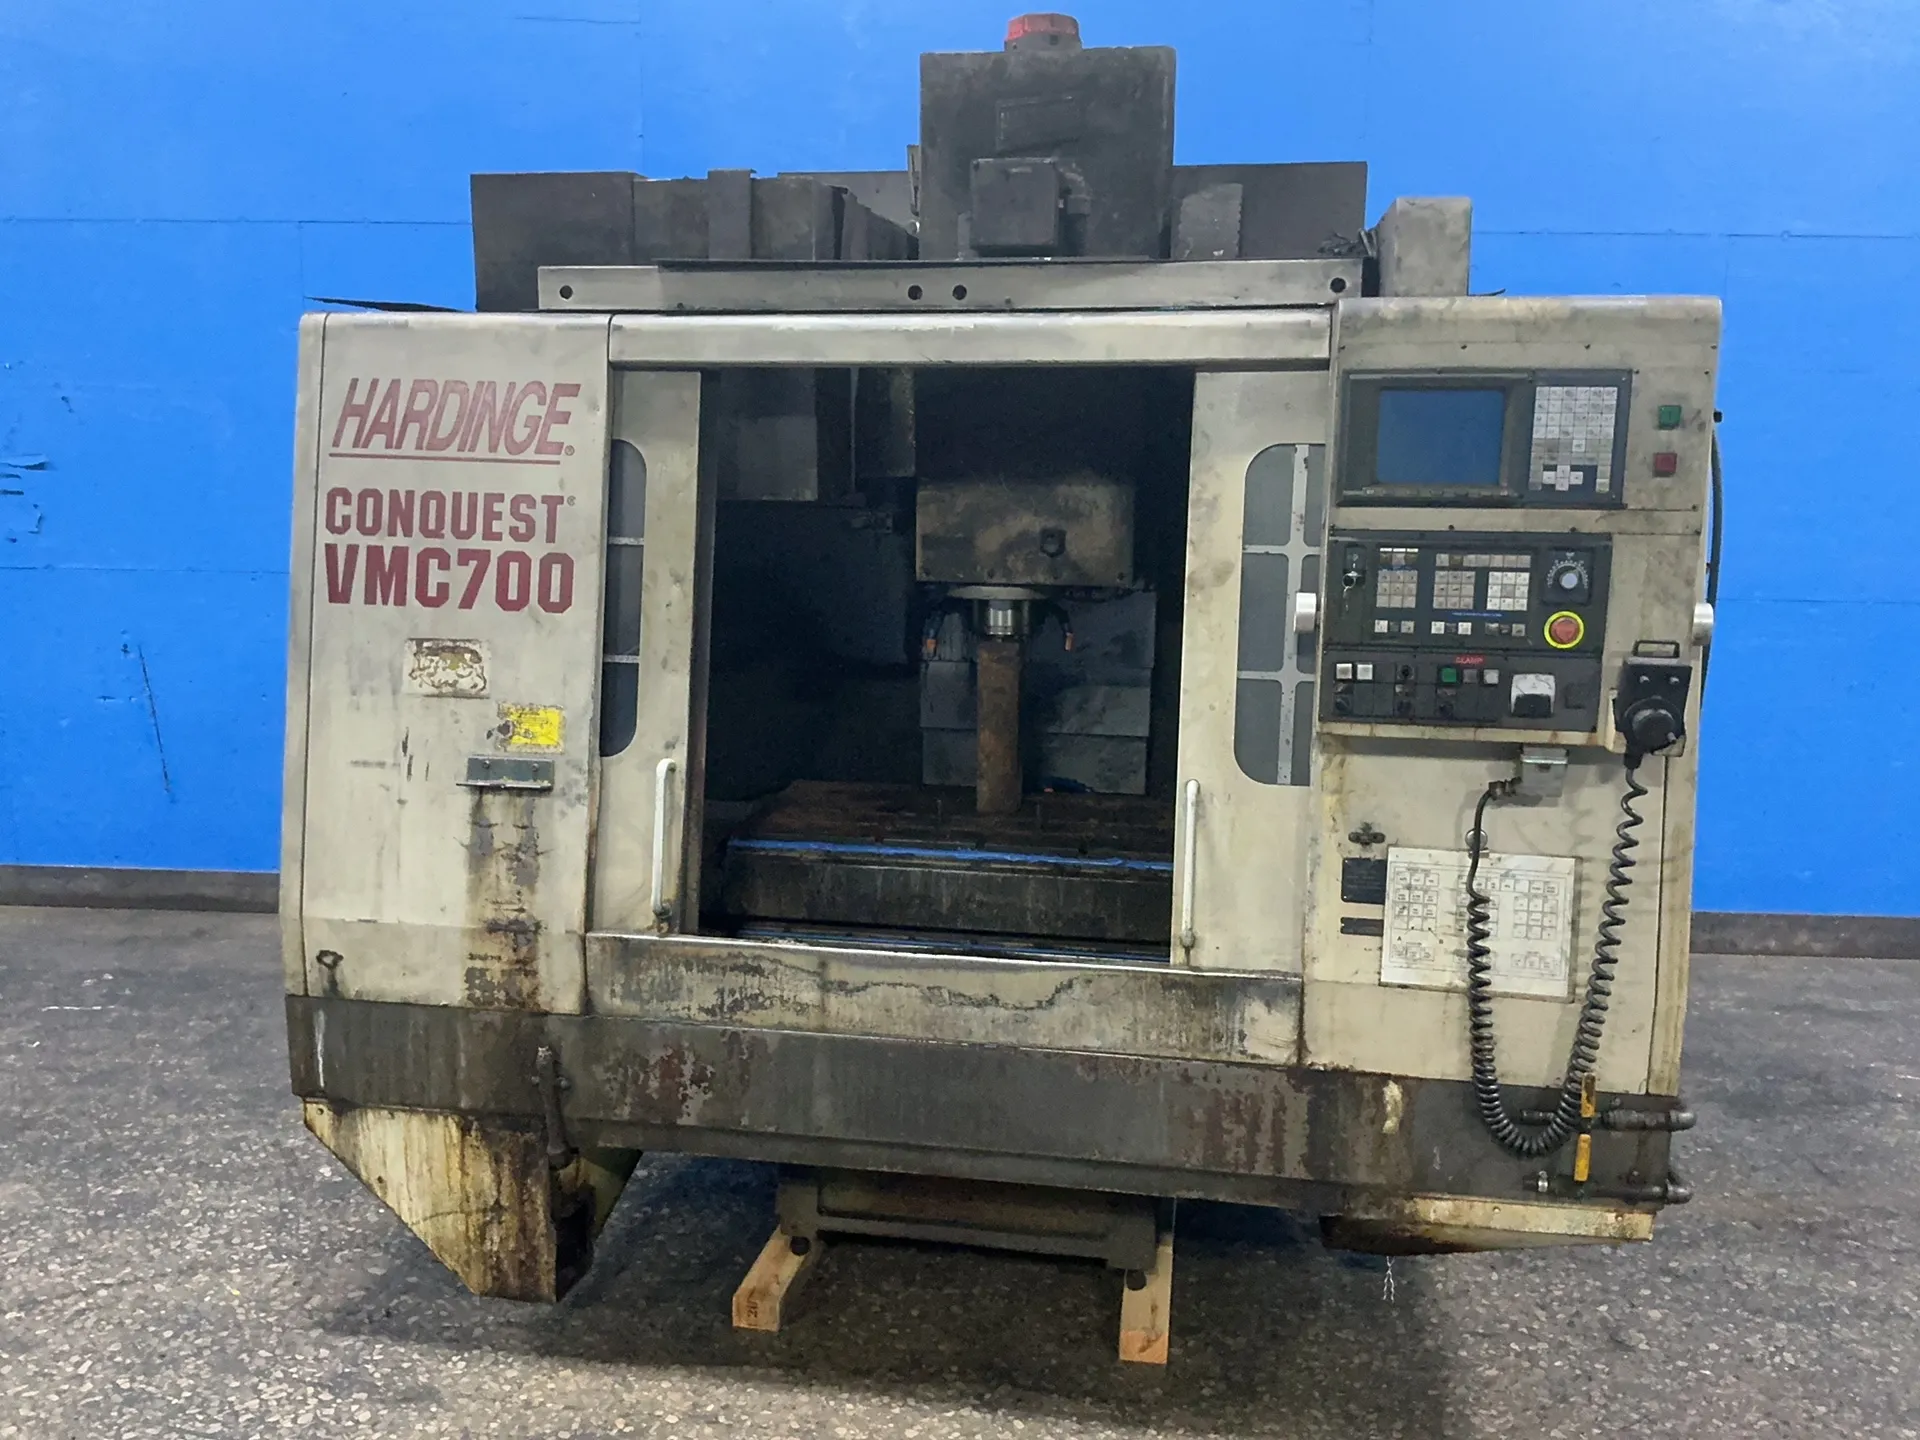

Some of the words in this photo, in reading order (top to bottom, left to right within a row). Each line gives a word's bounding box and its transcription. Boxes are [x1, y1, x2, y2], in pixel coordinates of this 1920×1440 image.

[332, 378, 581, 455] HARDINGE
[325, 487, 564, 543] CONQUEST
[325, 544, 574, 613] VMC700
